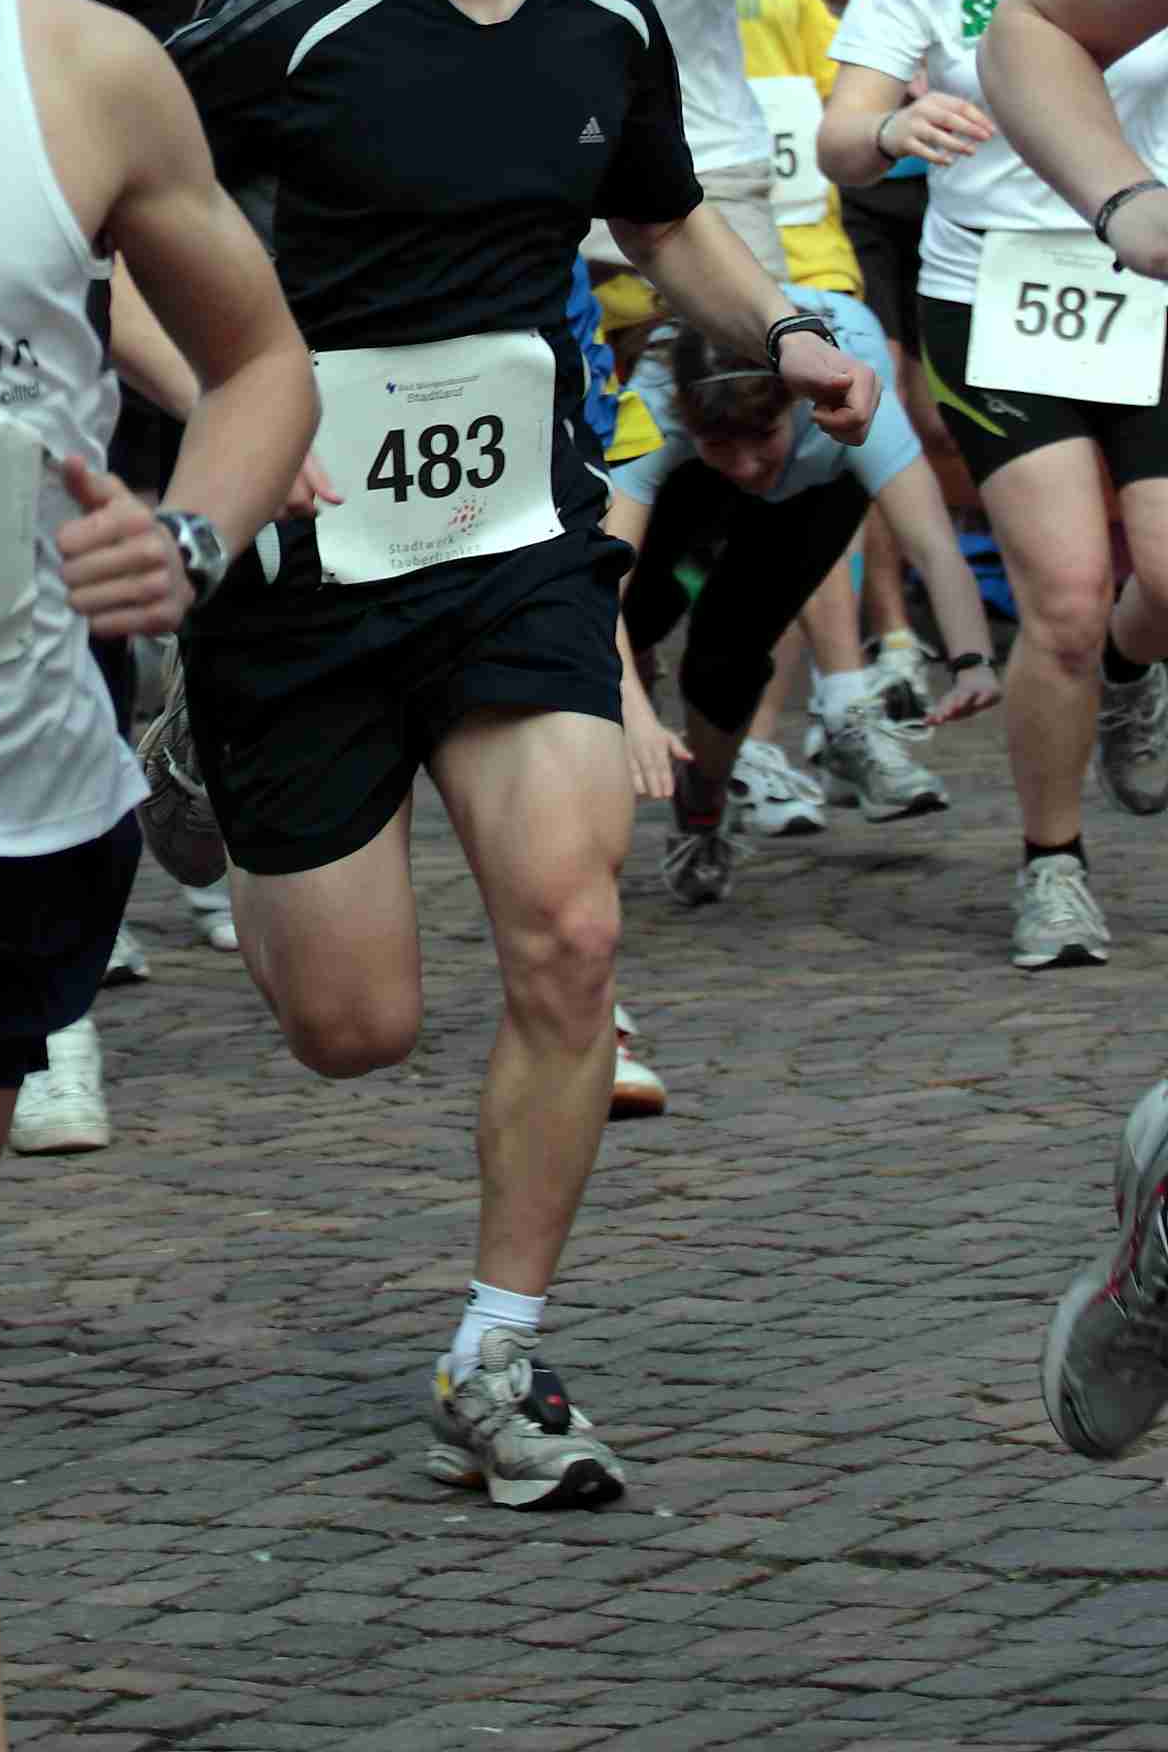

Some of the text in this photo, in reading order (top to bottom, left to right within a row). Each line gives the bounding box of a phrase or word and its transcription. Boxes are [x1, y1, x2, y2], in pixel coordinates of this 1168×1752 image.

[773, 132, 797, 179] 5
[1014, 281, 1128, 345] 587
[366, 414, 506, 503] 483
